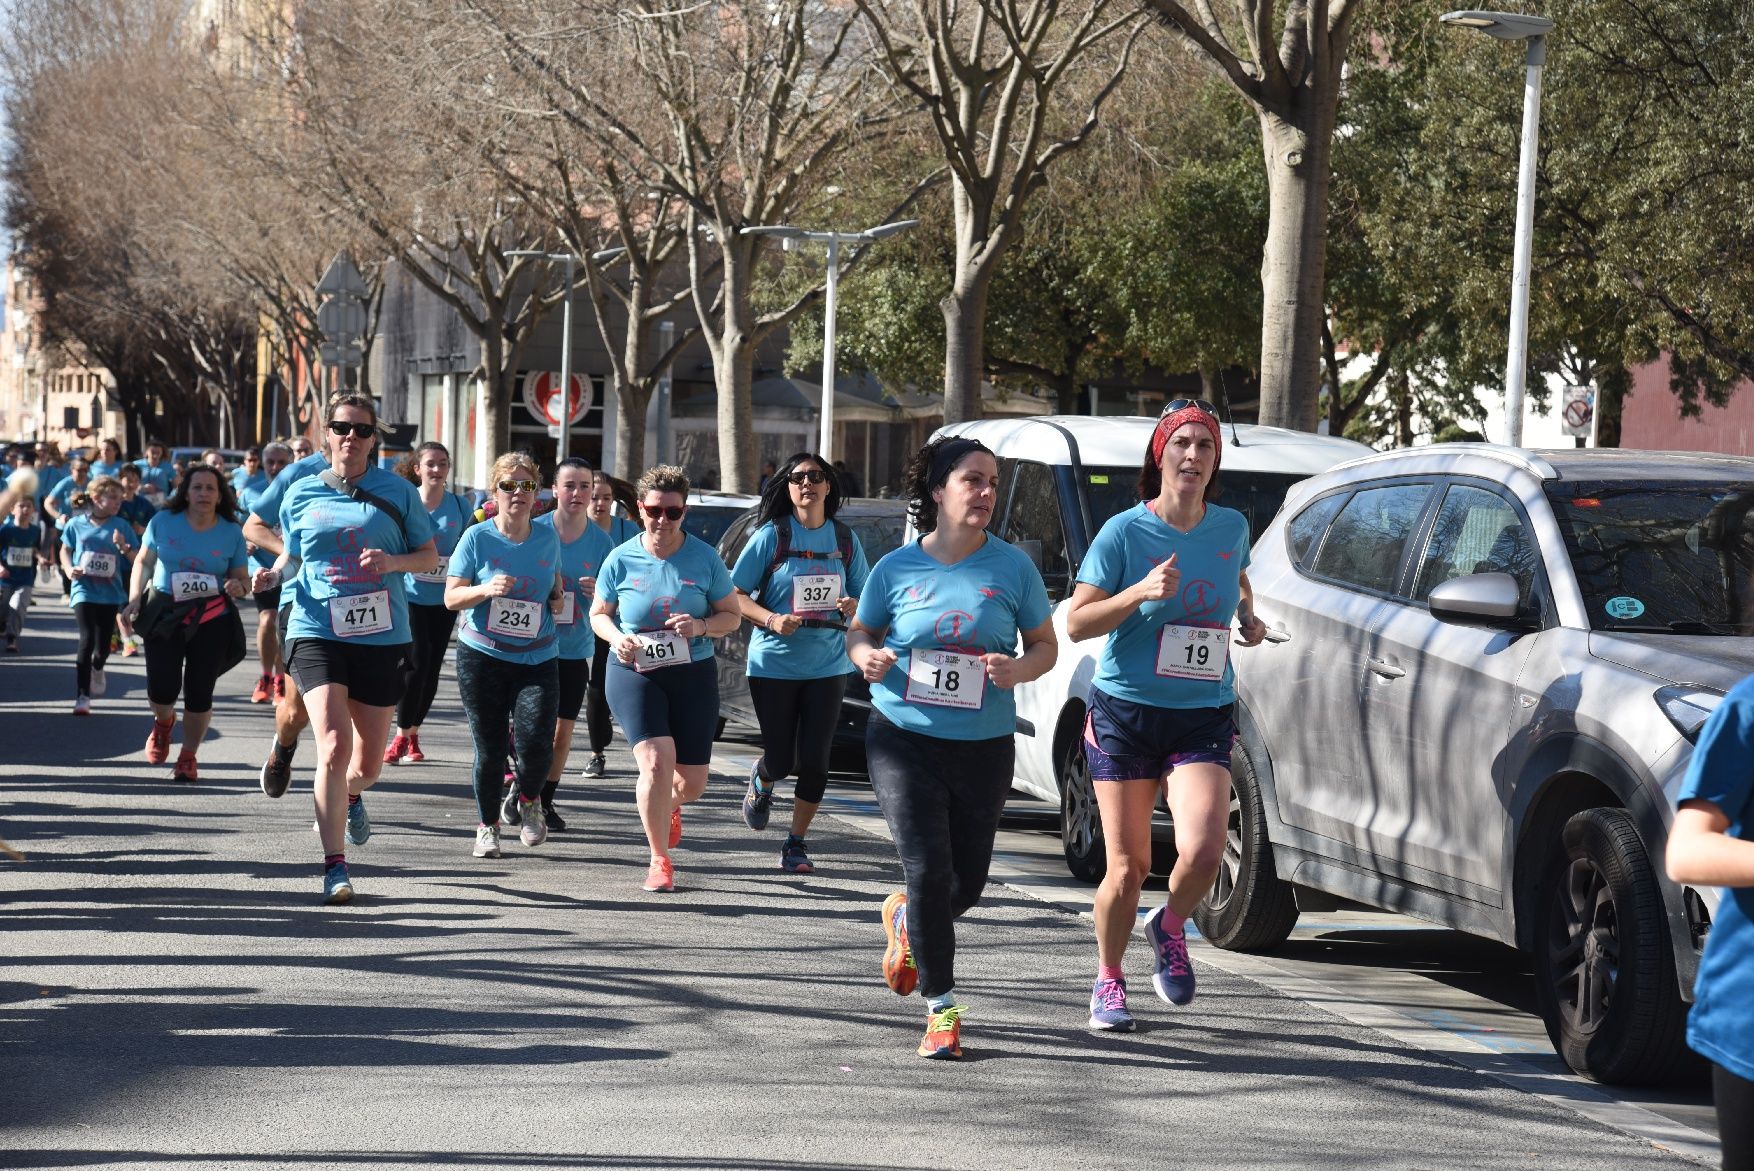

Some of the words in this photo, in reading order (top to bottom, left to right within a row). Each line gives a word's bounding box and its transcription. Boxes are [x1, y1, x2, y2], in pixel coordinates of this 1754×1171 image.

[87, 560, 109, 571] 498
[181, 581, 208, 593] 240
[803, 587, 831, 601] 337
[345, 606, 377, 625] 471
[499, 610, 530, 628] 234
[645, 641, 675, 659] 461
[1184, 643, 1209, 666] 19
[931, 669, 960, 691] 18
